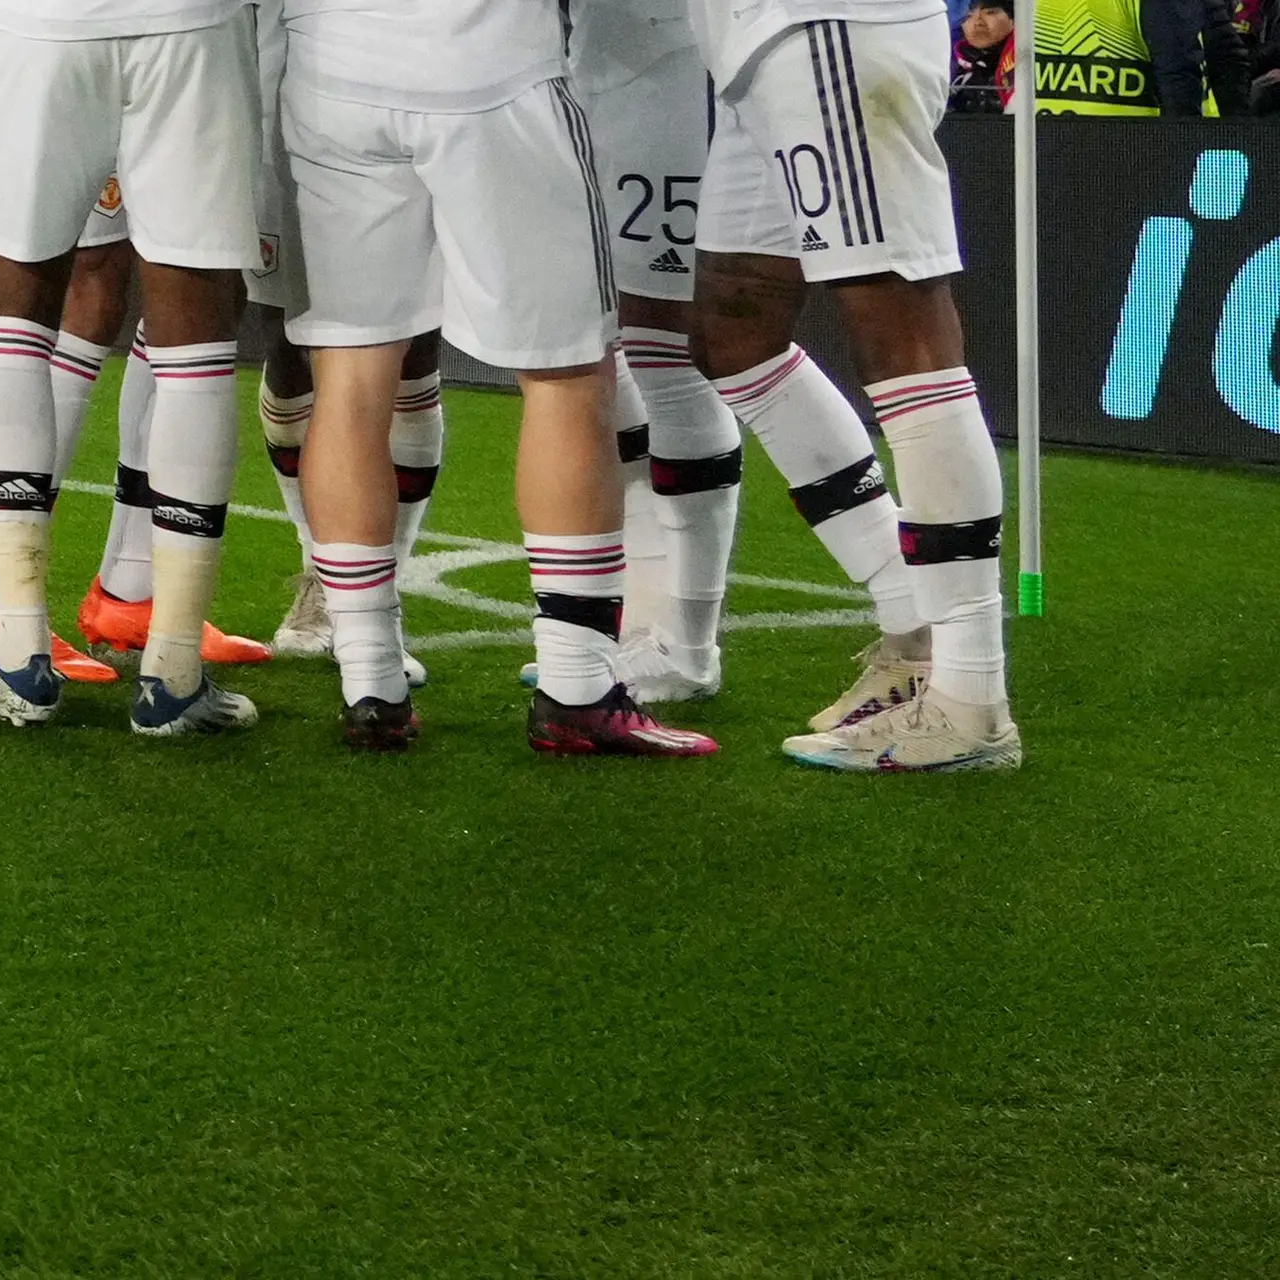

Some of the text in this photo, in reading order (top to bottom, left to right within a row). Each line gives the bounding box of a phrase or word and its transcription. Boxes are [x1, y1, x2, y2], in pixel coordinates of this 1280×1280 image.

[1035, 61, 1146, 98] WARD
[774, 143, 833, 219] 10
[617, 173, 703, 246] 25
[648, 262, 690, 274] adidas
